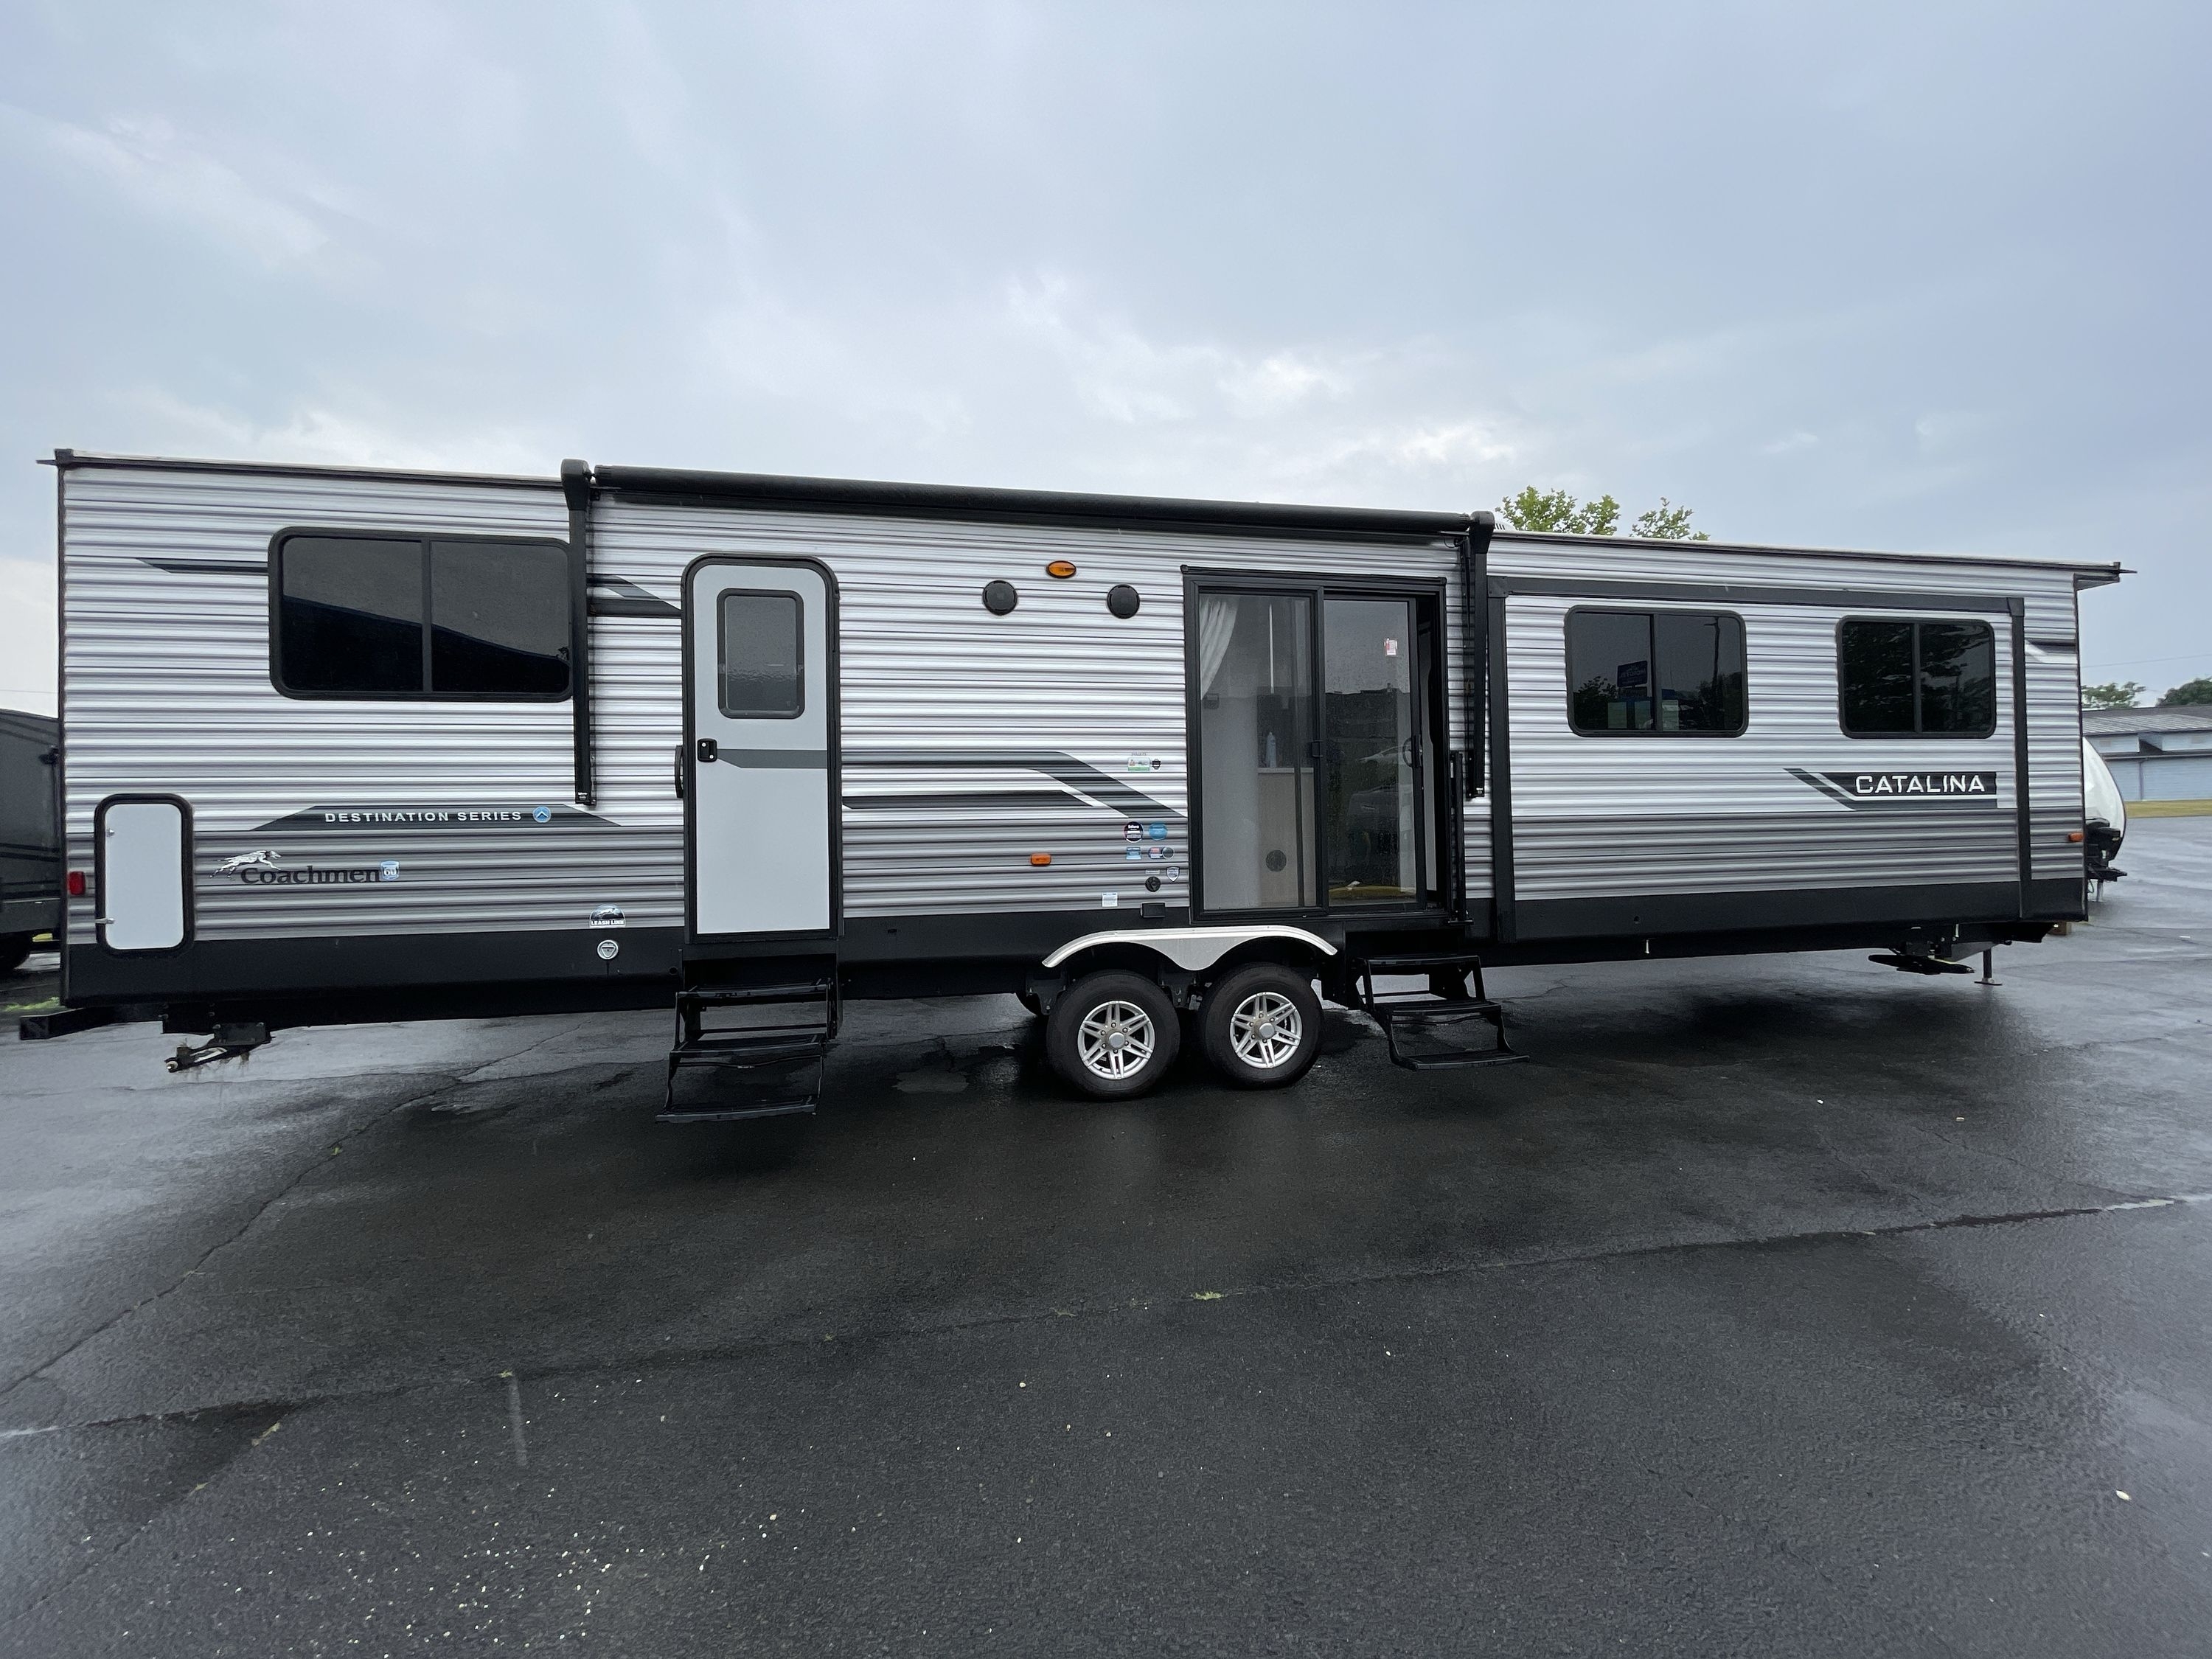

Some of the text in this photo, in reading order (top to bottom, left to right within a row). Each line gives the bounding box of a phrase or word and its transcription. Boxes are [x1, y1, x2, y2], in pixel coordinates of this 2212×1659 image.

[1855, 775, 1985, 793] CATALINA
[325, 811, 521, 822] DESTINATION SERIES
[240, 865, 381, 884] Coachmen
